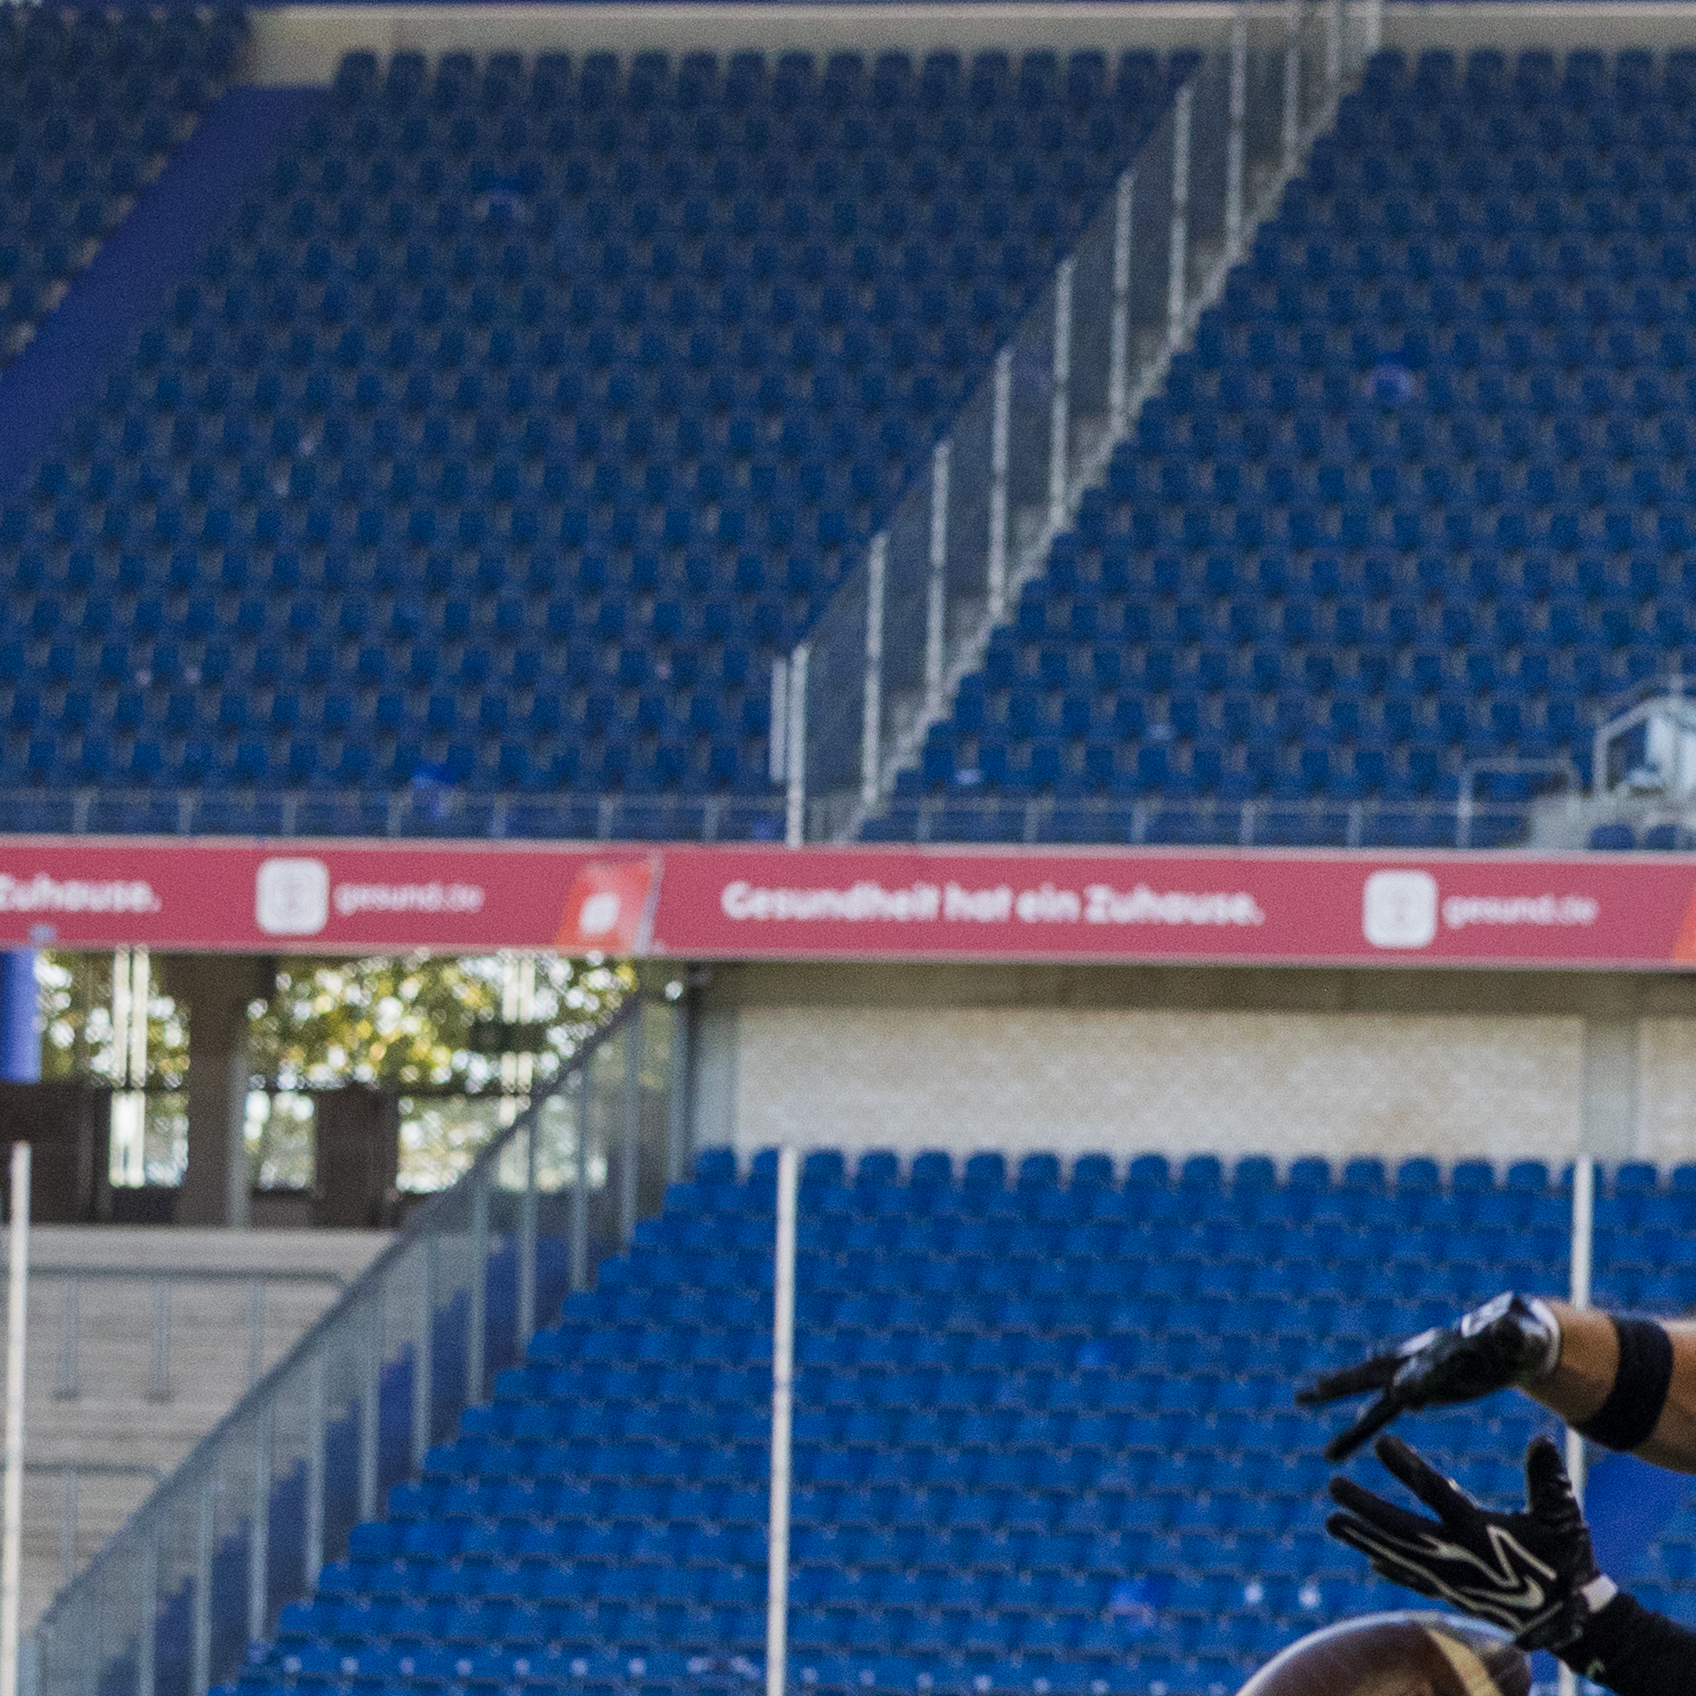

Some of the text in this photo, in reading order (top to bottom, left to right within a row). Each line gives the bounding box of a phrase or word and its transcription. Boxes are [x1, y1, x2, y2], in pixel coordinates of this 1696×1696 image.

[333, 879, 486, 916] gesund.de
[721, 881, 1264, 925] Gesundheit hat ein Zuhause.
[1442, 893, 1600, 931] gesund.de
